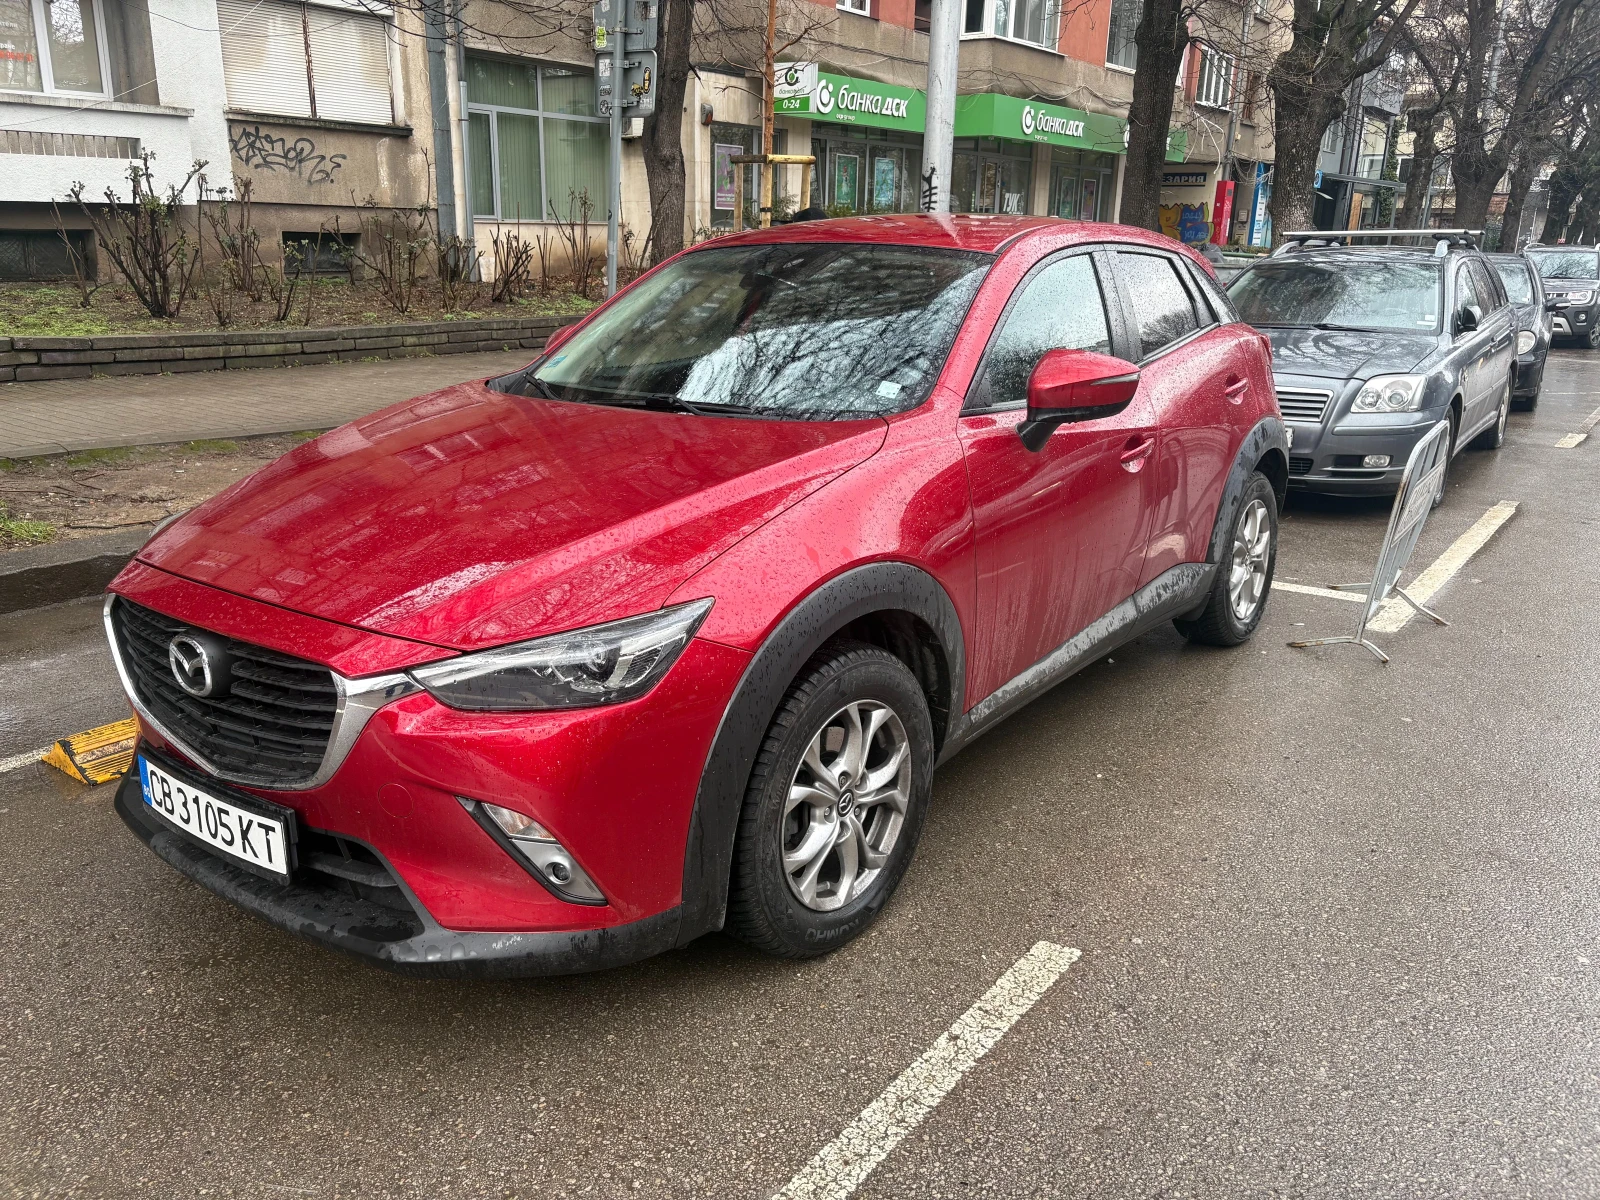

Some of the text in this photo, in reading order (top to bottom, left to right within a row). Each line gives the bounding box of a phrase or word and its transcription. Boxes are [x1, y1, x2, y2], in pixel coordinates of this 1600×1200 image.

[782, 99, 800, 109] 0-24
[837, 84, 882, 114] банка
[1036, 109, 1066, 134] банка
